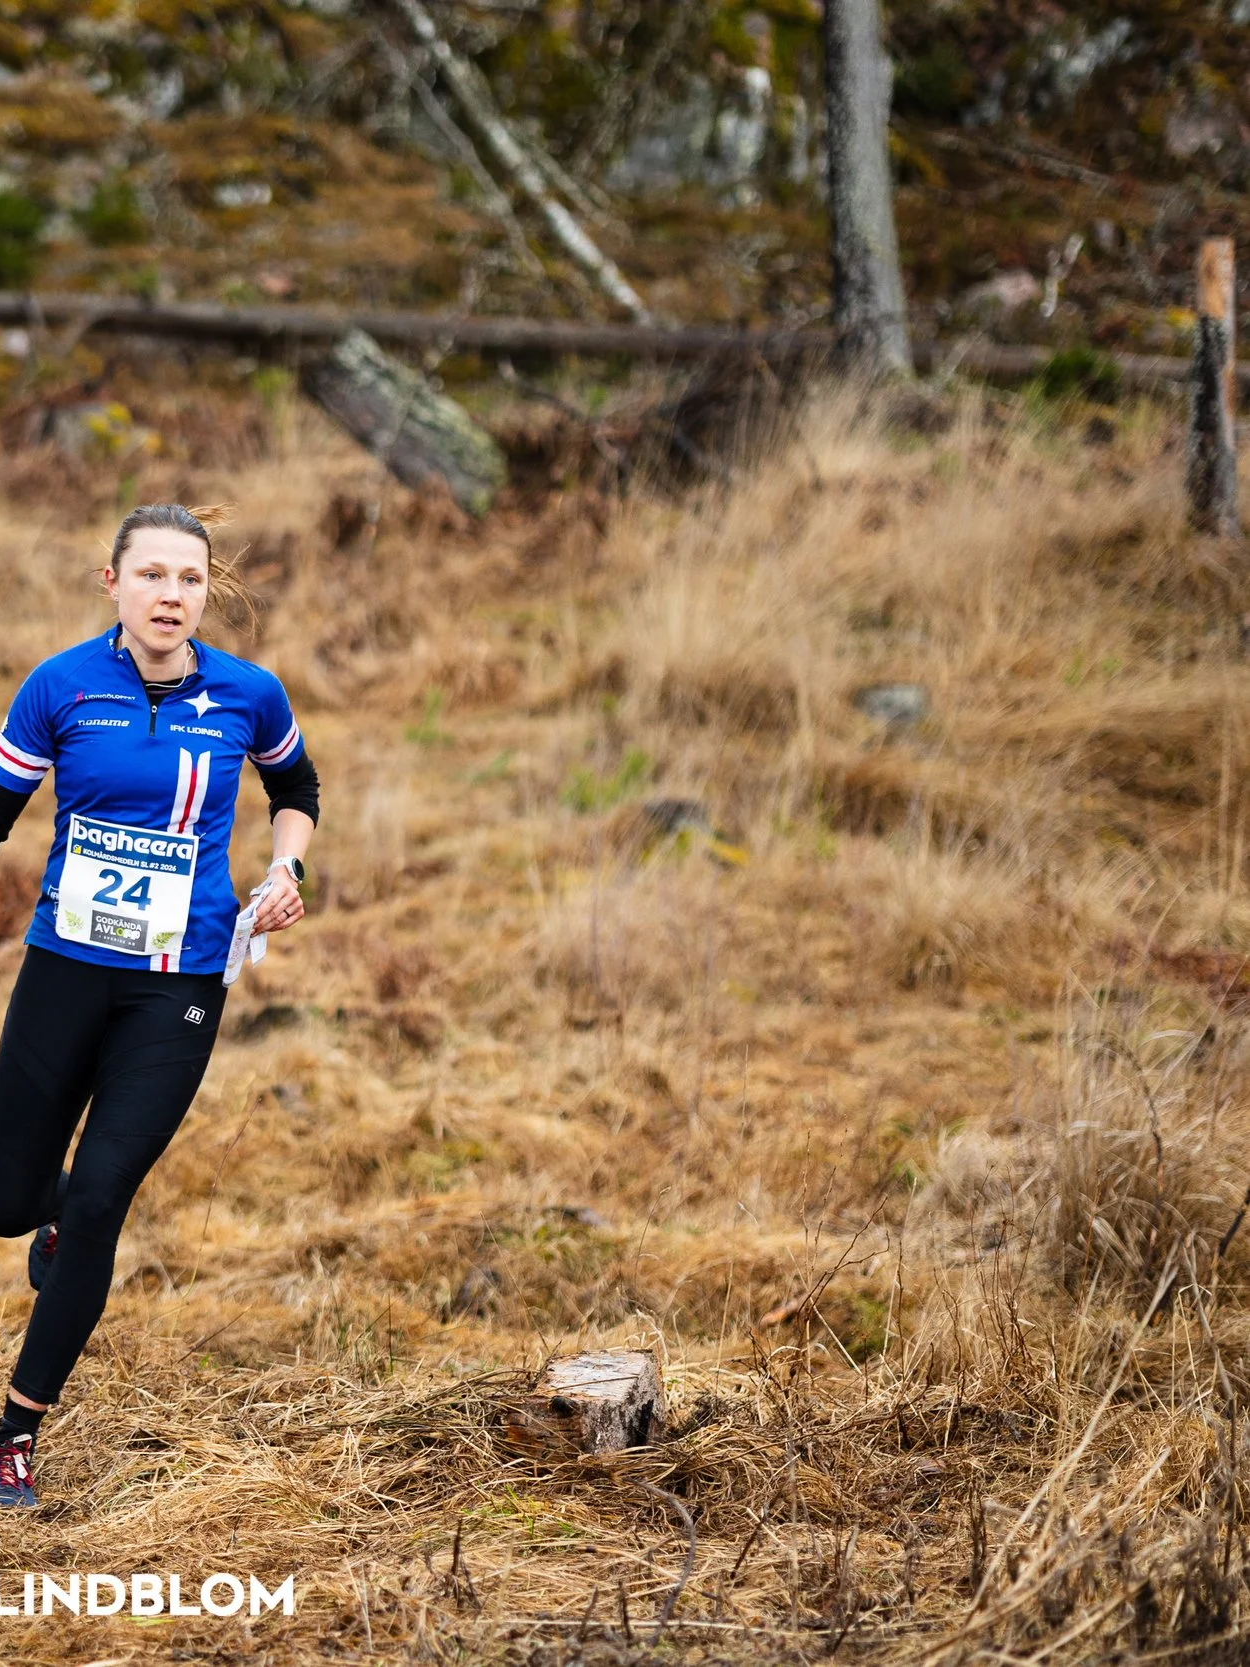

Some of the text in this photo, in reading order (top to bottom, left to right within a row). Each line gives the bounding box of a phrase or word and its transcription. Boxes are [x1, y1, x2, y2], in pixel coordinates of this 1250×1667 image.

[78, 719, 130, 727] noname
[170, 724, 186, 732] IFK
[73, 820, 193, 860] bagheera
[92, 868, 152, 911] 24
